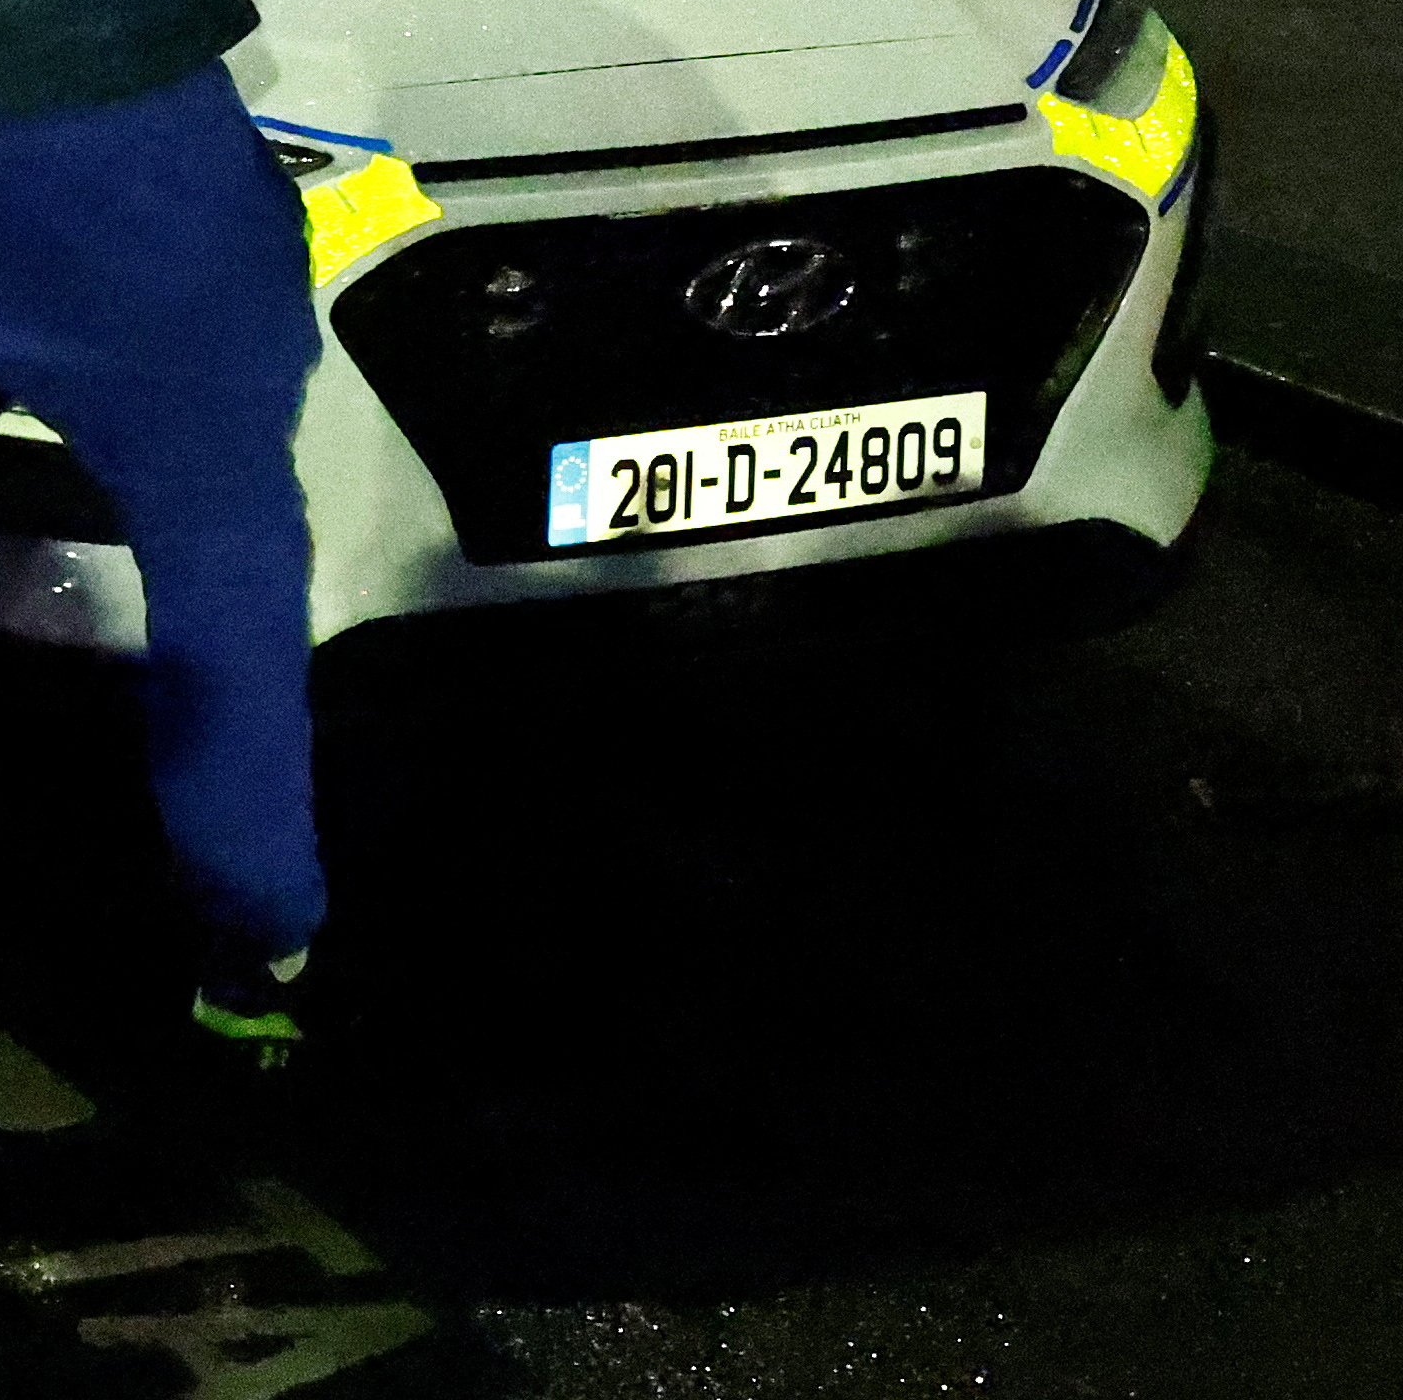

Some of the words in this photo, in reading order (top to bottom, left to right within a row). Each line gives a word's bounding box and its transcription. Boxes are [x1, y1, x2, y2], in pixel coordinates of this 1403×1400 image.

[719, 424, 761, 442] BAILE
[809, 412, 861, 431] CLIATH
[608, 417, 962, 530] 201-D-24809
